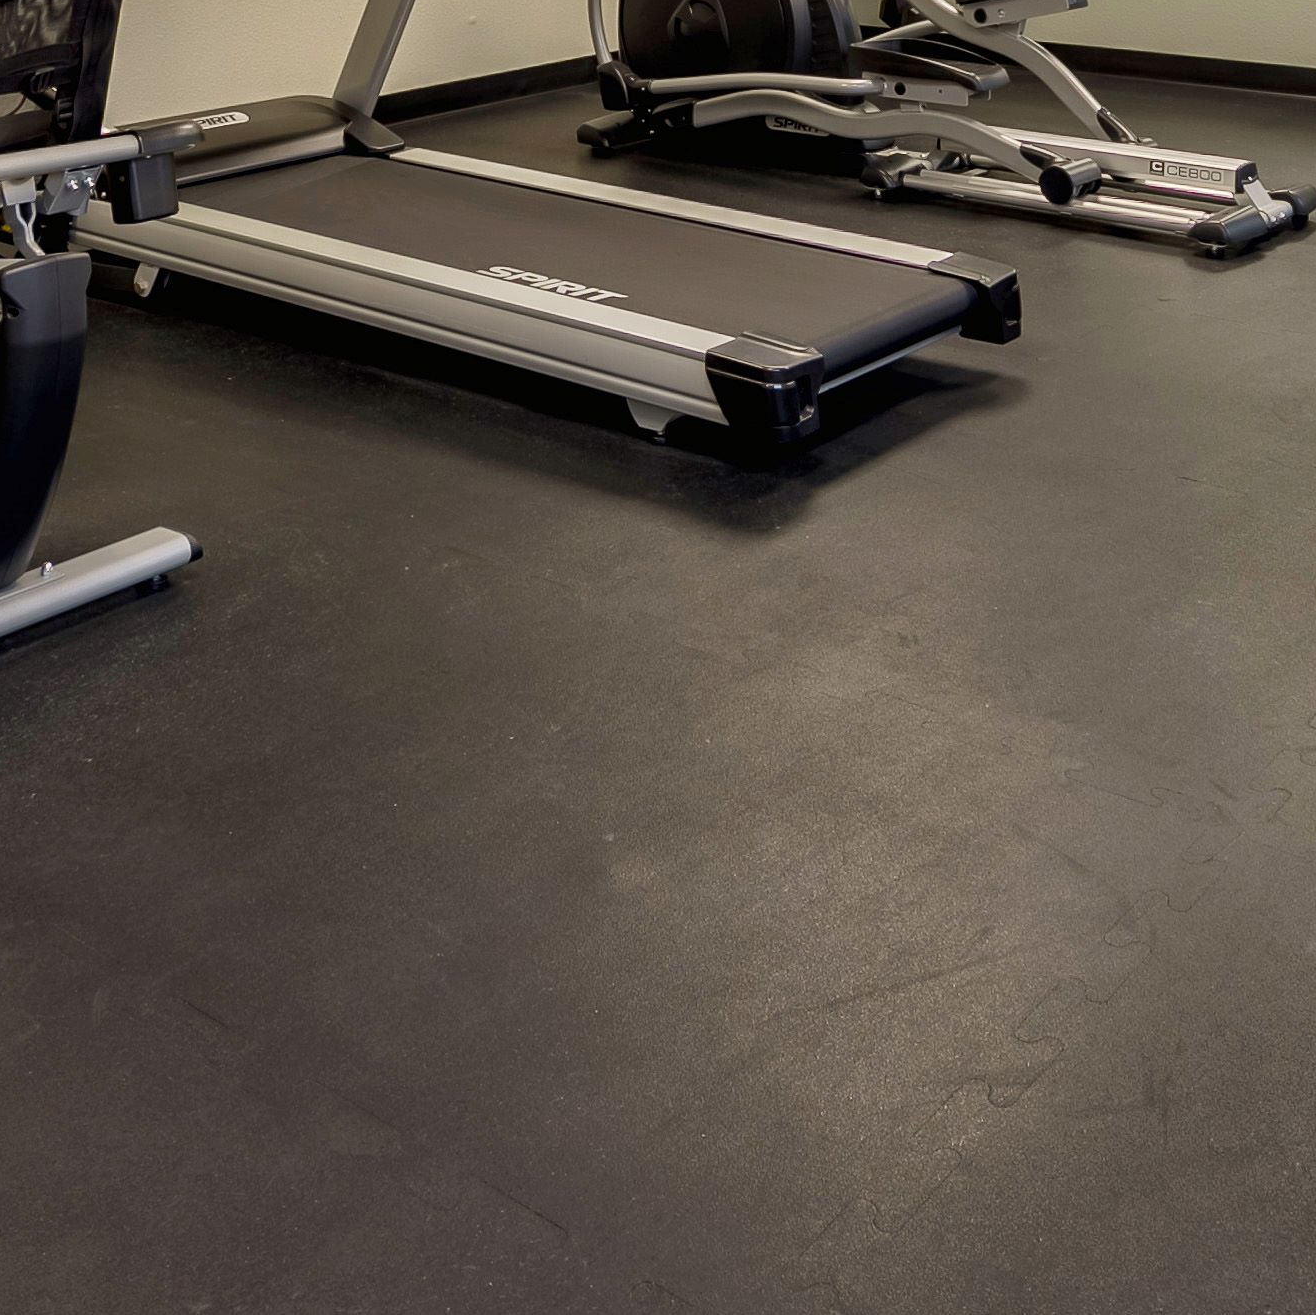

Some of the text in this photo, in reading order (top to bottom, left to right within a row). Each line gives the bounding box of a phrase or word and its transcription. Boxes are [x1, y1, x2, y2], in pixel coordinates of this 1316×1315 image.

[197, 114, 236, 126] PIRIT
[1166, 165, 1222, 182] CE800
[475, 265, 629, 301] SPIRIT
